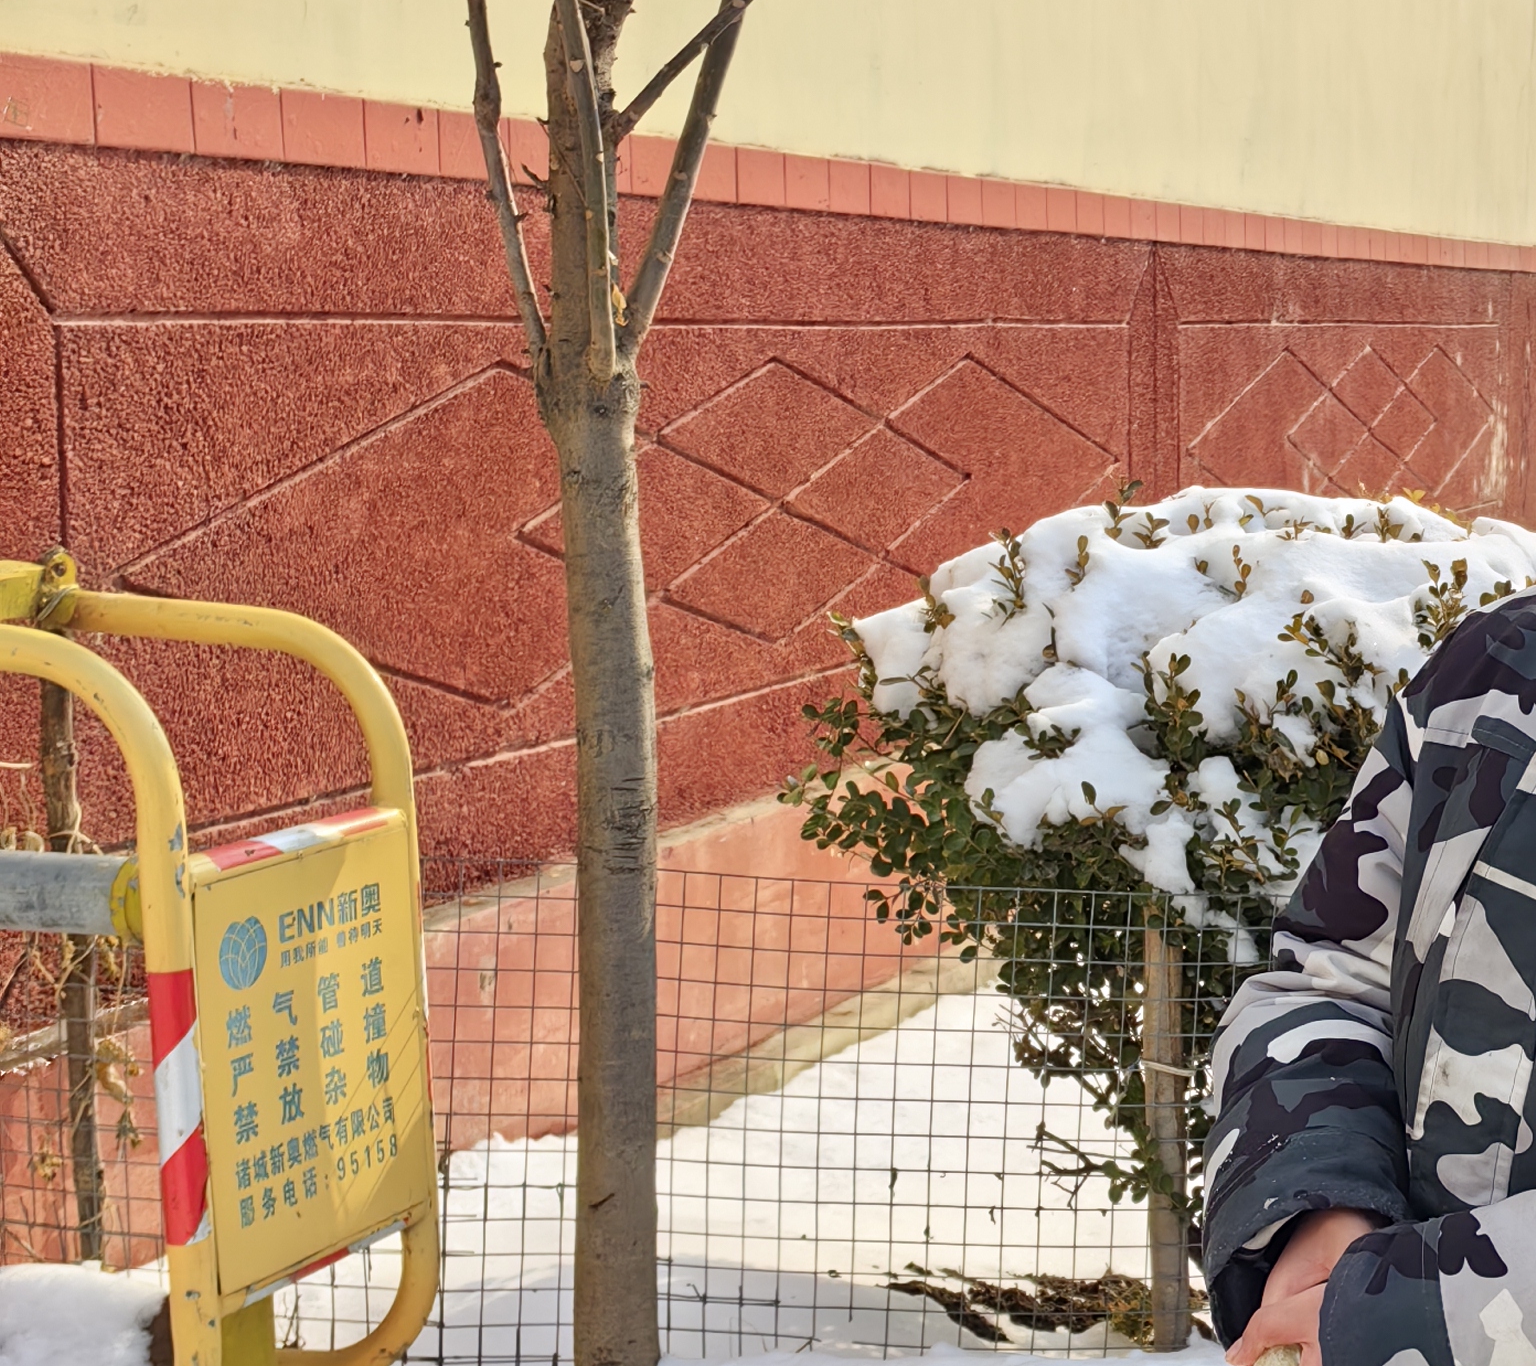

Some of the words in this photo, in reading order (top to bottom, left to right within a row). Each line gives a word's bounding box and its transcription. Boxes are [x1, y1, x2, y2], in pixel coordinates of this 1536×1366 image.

[278, 882, 382, 944] ENN新奥
[226, 956, 385, 1050] 燃气管道
[230, 1002, 387, 1098] 严禁碰撞
[233, 1048, 390, 1145] 禁放杂物
[235, 1096, 396, 1191] 诸城新奥燃气有限公司
